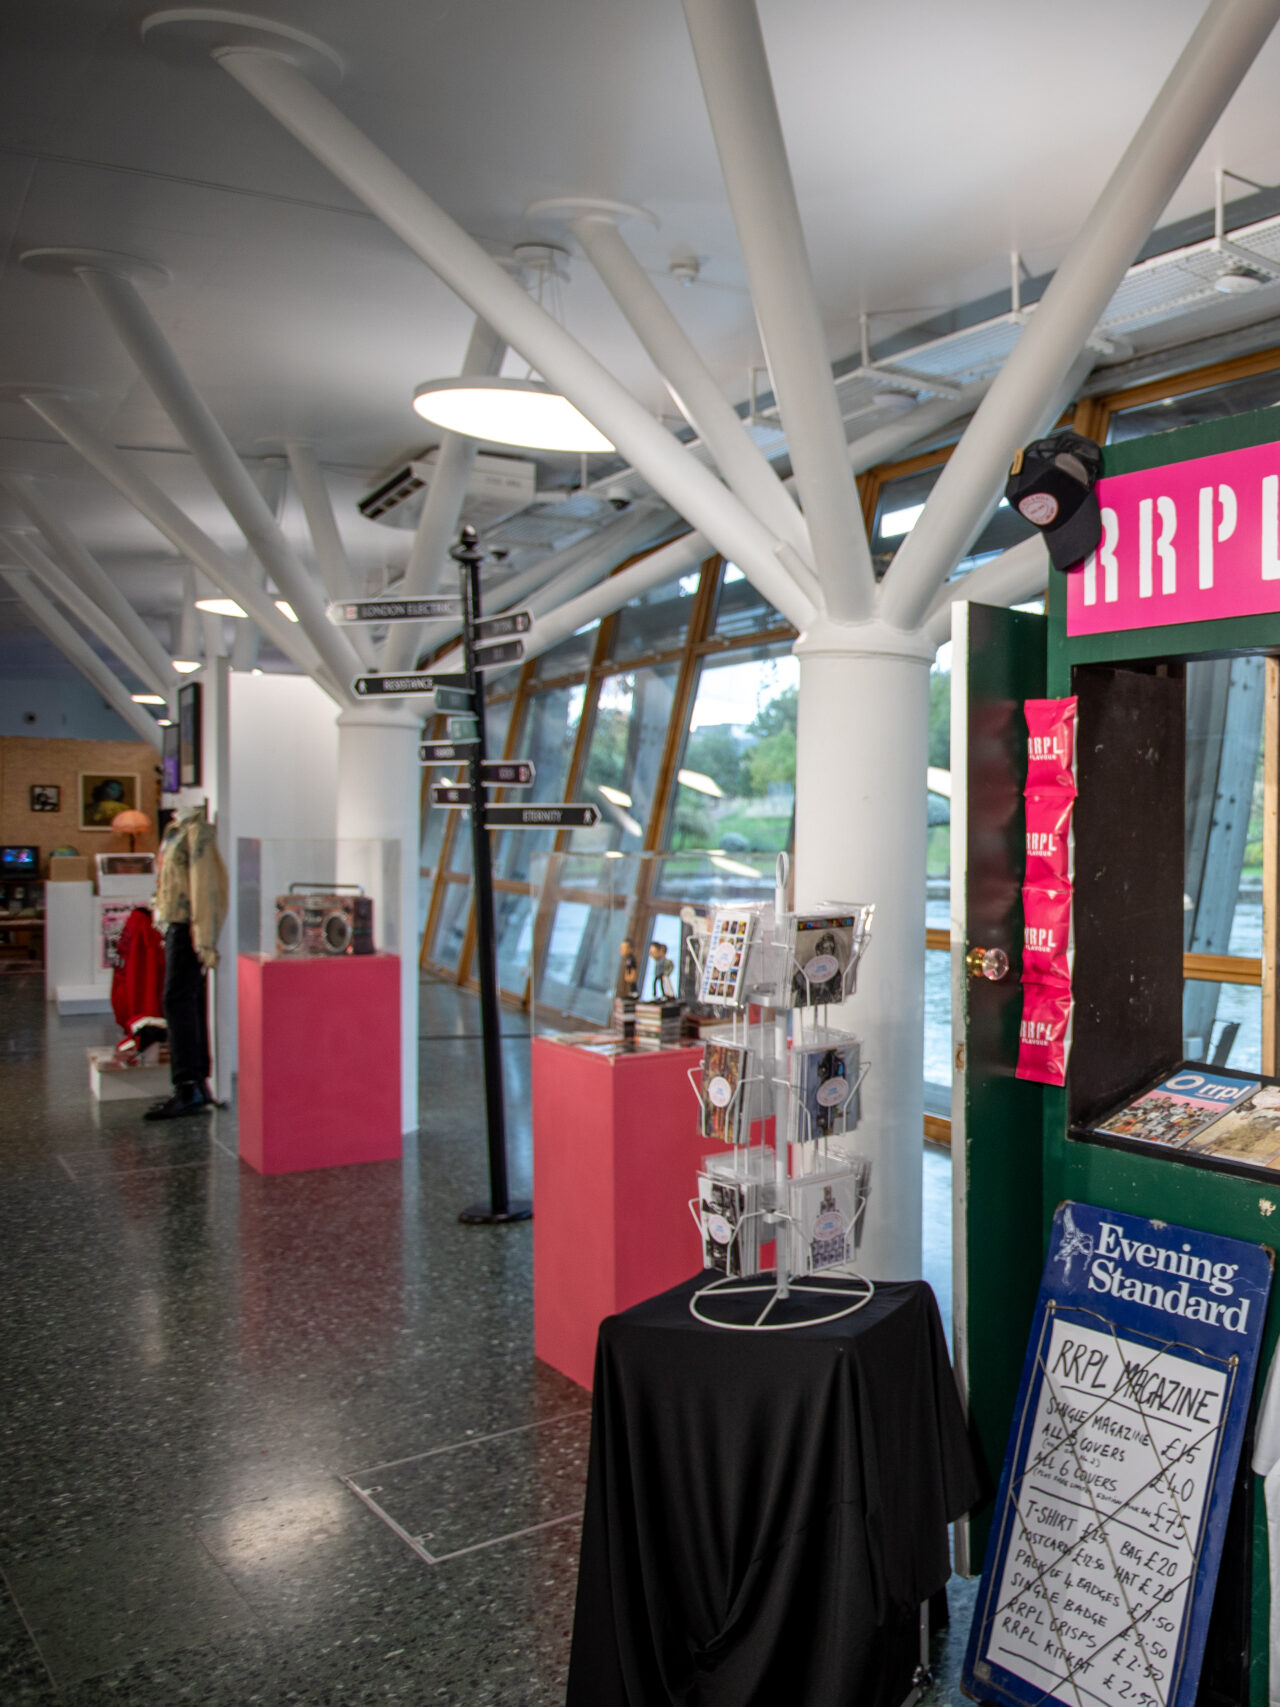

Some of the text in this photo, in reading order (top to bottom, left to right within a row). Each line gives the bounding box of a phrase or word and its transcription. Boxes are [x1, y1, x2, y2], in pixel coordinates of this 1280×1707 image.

[1198, 1083, 1251, 1101] rrpl
[1094, 1221, 1239, 1296] Evening
[1088, 1258, 1250, 1335] Standard
[1052, 1339, 1219, 1425] RRPL MAGAZINE
[1042, 1423, 1126, 1463] ALL COVERS
[1046, 1396, 1202, 1464] SINGLE MAGAZINE £15
[1034, 1451, 1118, 1493] ALL 6 COVERS
[1150, 1467, 1195, 1502] £40
[1024, 1501, 1078, 1532] T-SHIRT
[1149, 1502, 1191, 1540] £75
[1015, 1549, 1047, 1572] PACK
[1063, 1574, 1074, 1590] 4
[1077, 1577, 1121, 1608] BADGES
[1114, 1567, 1137, 1587] HAT
[1119, 1541, 1178, 1578] BAG £20
[1010, 1573, 1109, 1627] SINGLE BADGE
[1002, 1617, 1039, 1646] RRPL
[1007, 1596, 1097, 1649] RRPL CRISPS
